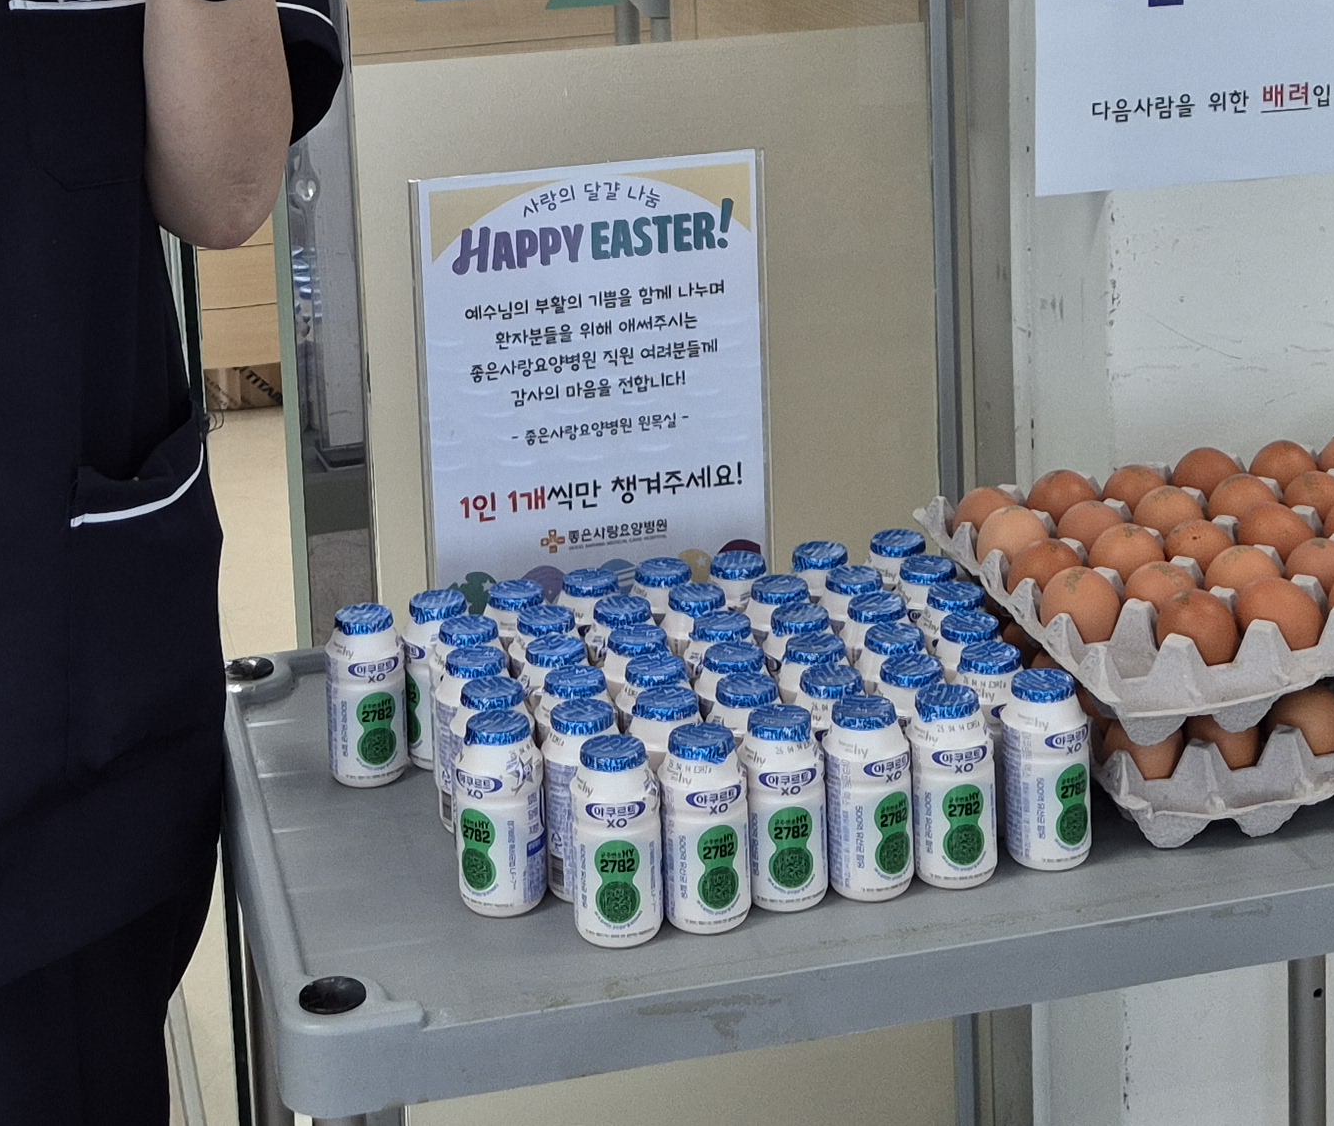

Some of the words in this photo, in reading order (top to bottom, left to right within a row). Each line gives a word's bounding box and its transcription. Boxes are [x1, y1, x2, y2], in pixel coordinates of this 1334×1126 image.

[1091, 93, 1195, 123] 다음사람을
[1208, 90, 1249, 113] 위한
[523, 185, 575, 218] 사랑의
[584, 181, 620, 202] 달걀
[628, 186, 661, 208] 나눔
[452, 224, 584, 275] HAPPY
[591, 198, 734, 260] EASTER!
[465, 301, 529, 321] 예수님의
[535, 295, 582, 314] 부활의
[589, 288, 631, 308] 기쁨을
[639, 285, 672, 305] 함께
[679, 280, 725, 298] 나누며
[495, 324, 573, 350] 환자분들을
[580, 318, 612, 337] 위해
[619, 312, 697, 333] 애써주시는
[470, 351, 596, 384] 좋은사랑요양병원
[603, 346, 634, 367] 직원
[641, 338, 718, 361] 여러분들께
[511, 385, 559, 407] 감사의
[566, 377, 611, 399] 마음을
[618, 370, 686, 393] 전합니다!
[525, 418, 632, 446] 좋은사랑요양병원
[638, 412, 677, 431] 원목실
[460, 492, 496, 522] 1인
[508, 480, 601, 513] 1개씩만
[611, 462, 743, 503] 챙겨주세요!
[568, 518, 667, 543] 좋은사랑요양병원
[356, 661, 394, 674] 야쿠르트
[368, 673, 386, 684] XO
[362, 707, 392, 722] 2782
[1054, 729, 1086, 745] 야쿠르트
[1066, 742, 1082, 755] XO
[942, 750, 981, 764] 야쿠르트
[874, 758, 908, 773] 야쿠르트
[954, 762, 974, 774] XO
[768, 773, 809, 786] 야쿠르트
[885, 770, 902, 783] XO
[467, 788, 484, 800] XO
[696, 789, 736, 805] 야쿠르트
[781, 785, 801, 796] XO
[1061, 780, 1087, 799] 2782
[594, 804, 636, 818] 야쿠르트
[709, 803, 729, 815] XO
[948, 803, 981, 818] 2782
[606, 818, 628, 829] XO
[880, 808, 908, 828] 2782
[463, 826, 491, 844] 2782
[774, 825, 809, 840] 2782
[703, 843, 735, 860] 2782
[600, 859, 635, 873] 2782
